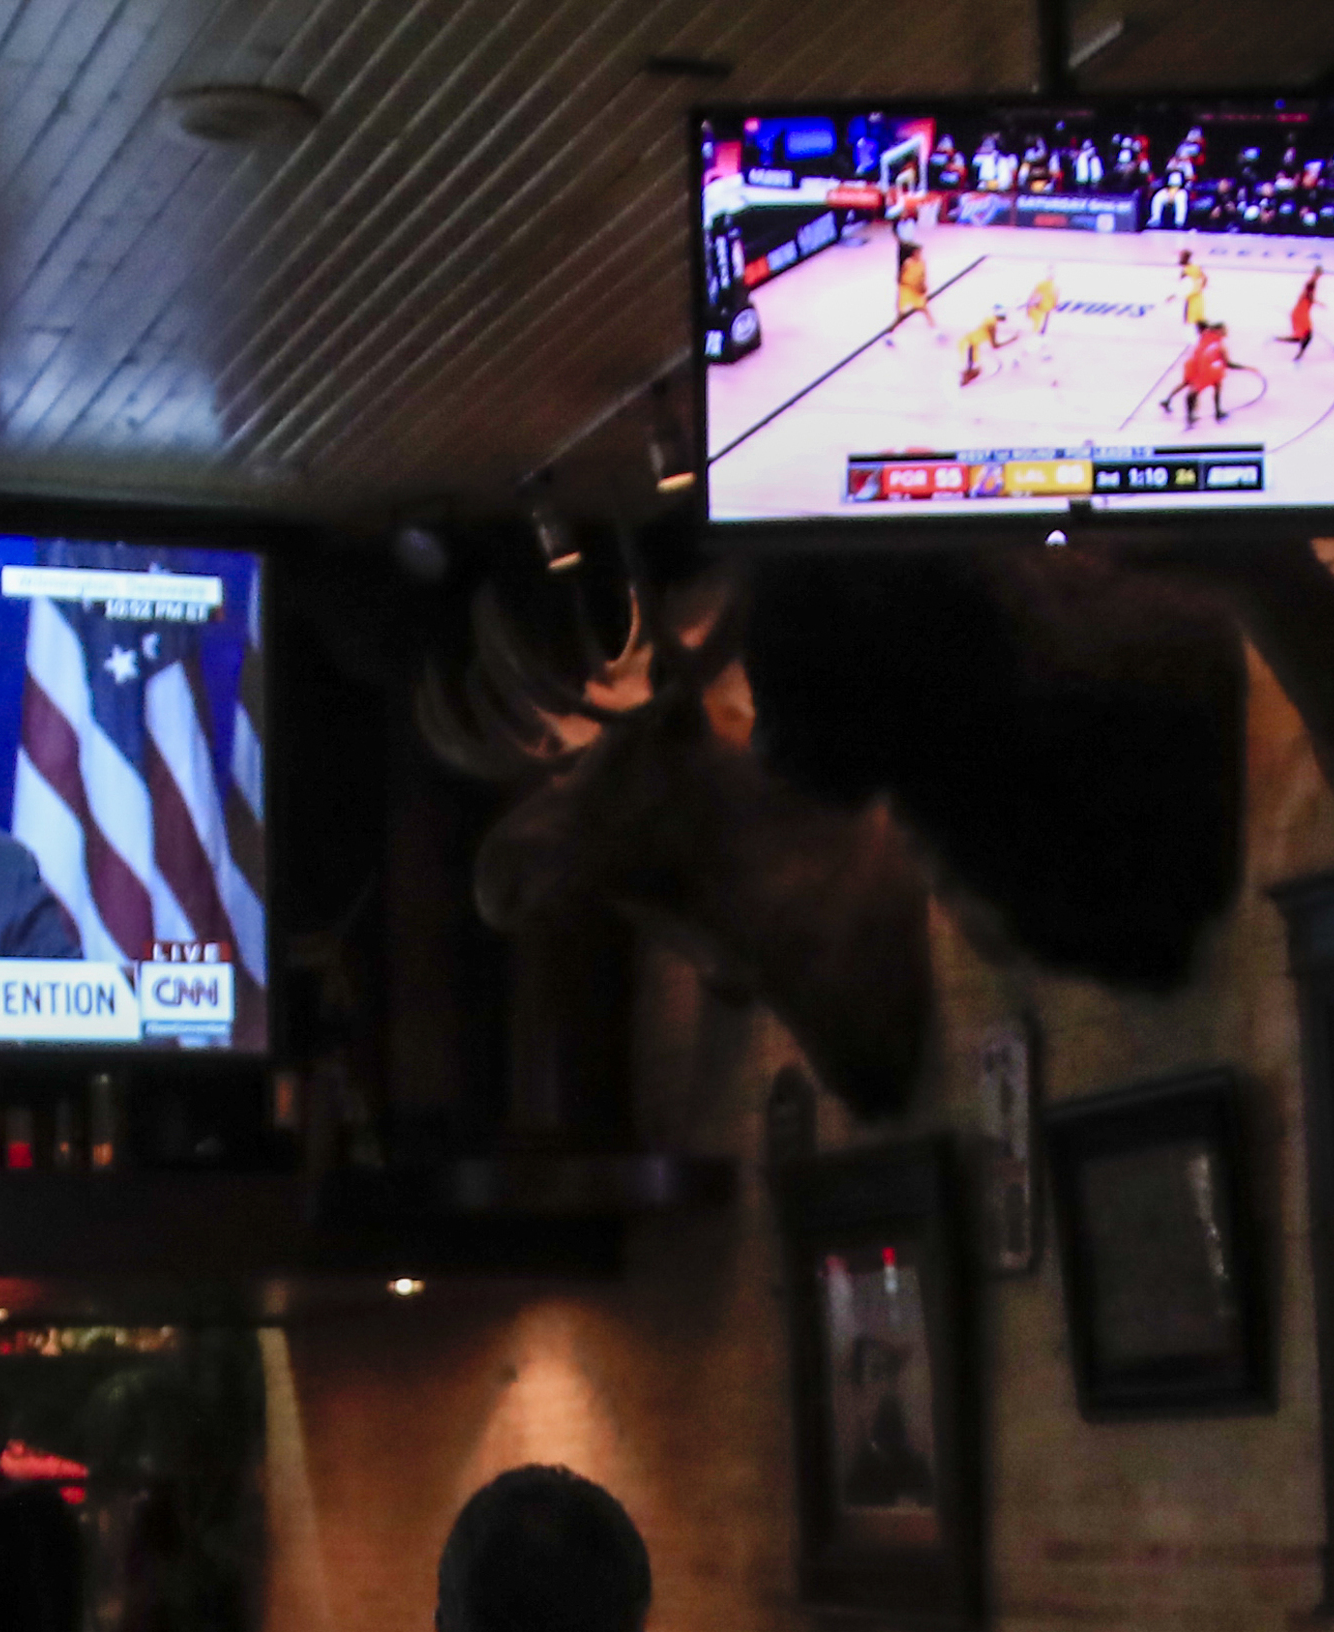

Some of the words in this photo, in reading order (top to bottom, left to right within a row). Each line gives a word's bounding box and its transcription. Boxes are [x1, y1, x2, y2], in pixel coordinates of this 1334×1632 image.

[889, 469, 927, 486] POR
[1129, 466, 1167, 486] 1:10
[1207, 465, 1259, 487] ESPN
[153, 942, 220, 963] LIVE
[152, 976, 219, 1007] CNN
